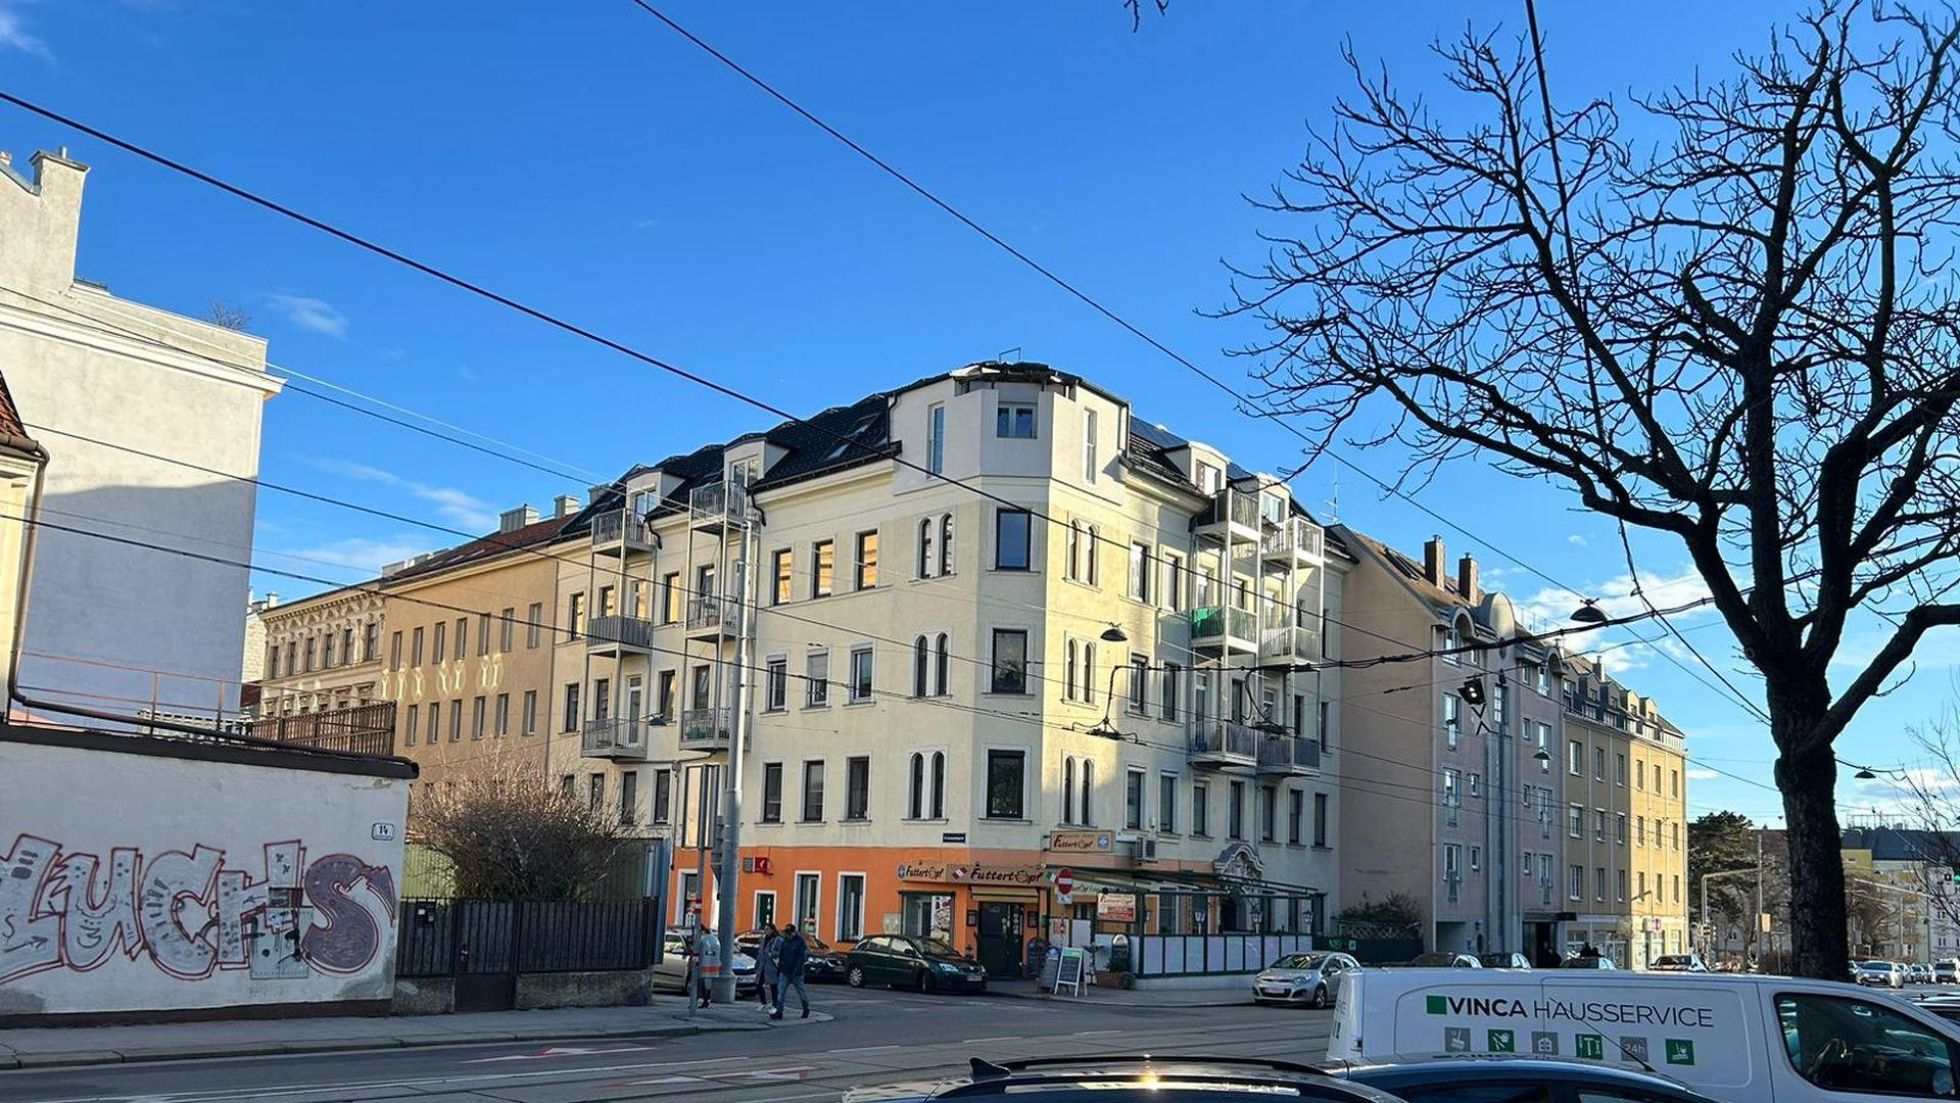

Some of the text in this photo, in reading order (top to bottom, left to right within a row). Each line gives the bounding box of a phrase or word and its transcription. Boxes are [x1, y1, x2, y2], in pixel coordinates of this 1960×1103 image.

[1448, 997, 1715, 1028] VINCA HAUSSERVICE
[1624, 1042, 1646, 1055] 24h
